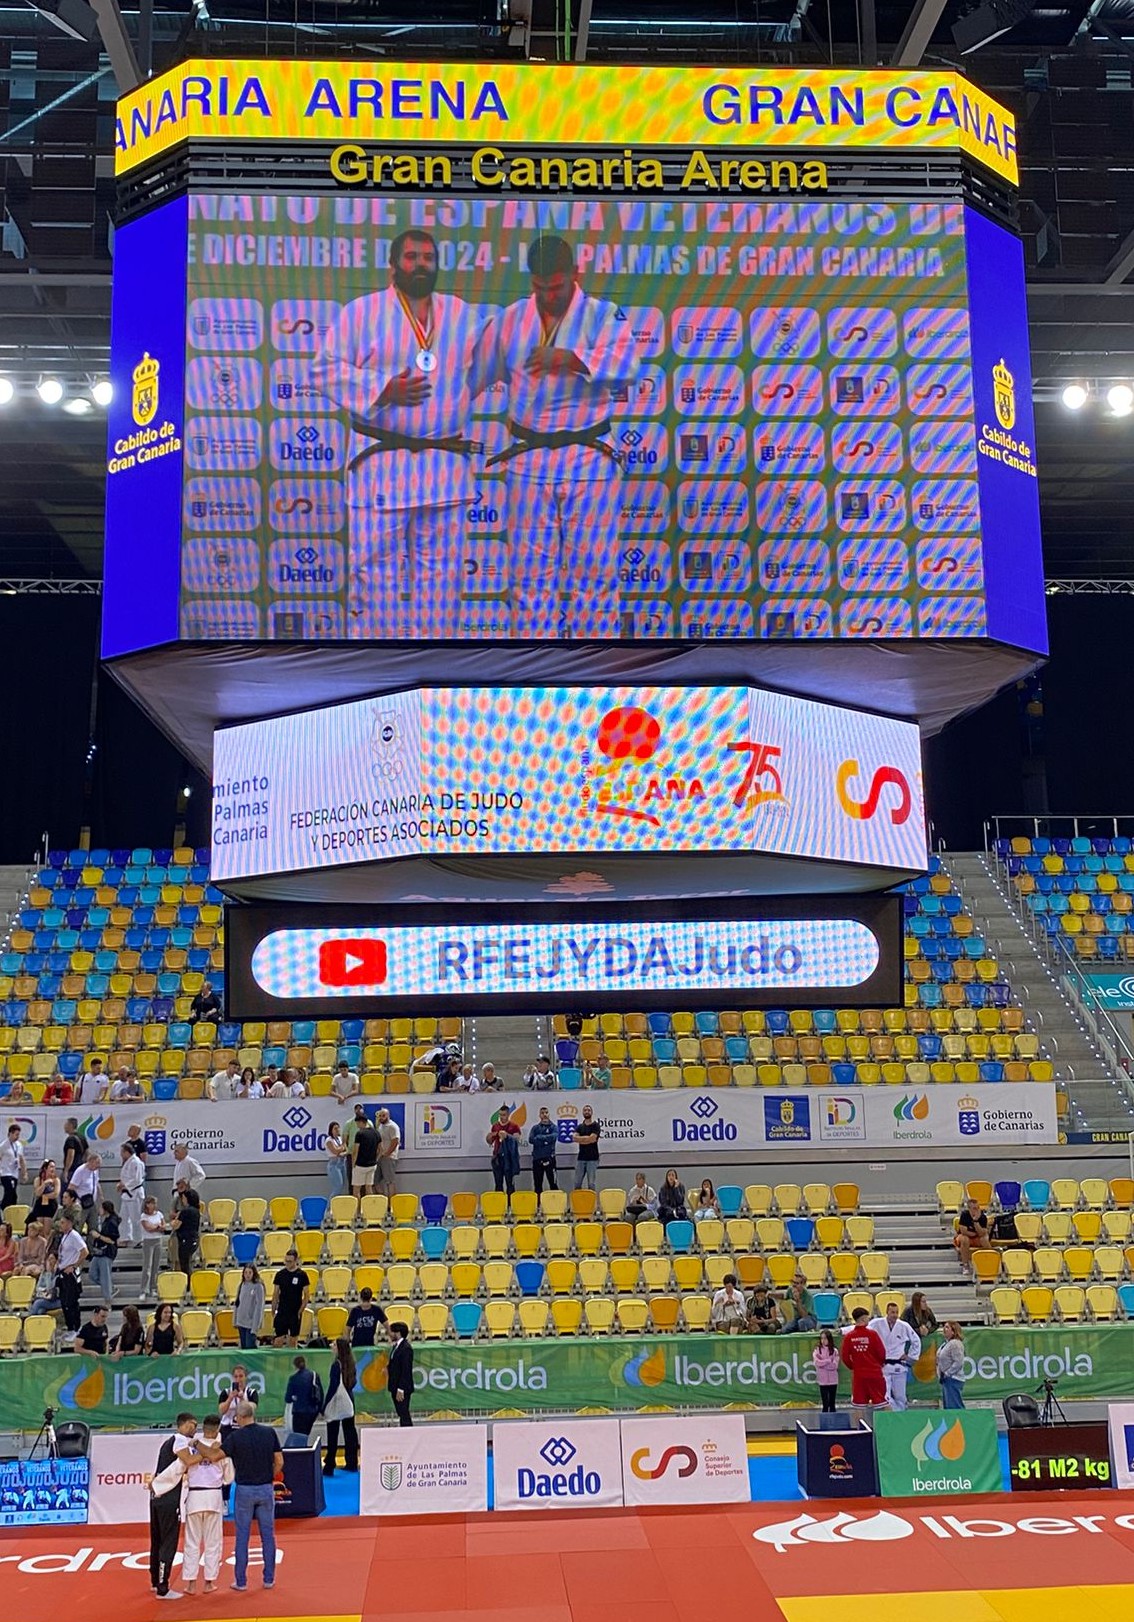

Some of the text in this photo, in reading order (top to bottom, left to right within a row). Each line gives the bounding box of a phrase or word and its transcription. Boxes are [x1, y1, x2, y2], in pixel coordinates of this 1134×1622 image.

[303, 78, 509, 121] ARENA
[702, 84, 865, 126] GRAN
[330, 144, 828, 189] Gran Canaria Arena
[335, 199, 397, 225] DE
[203, 233, 367, 268] DICIEMBRE
[438, 240, 493, 272] 024
[577, 242, 689, 275] PALMAS
[696, 246, 732, 276] DE
[738, 246, 815, 277] GRAN
[821, 246, 945, 277] CANARIA
[114, 421, 175, 455] Cabildo de
[982, 424, 1031, 458] Cabildo de
[108, 437, 181, 474] Gran Canaria
[280, 442, 334, 461] Daedo
[978, 439, 1037, 477] Gran Canaria
[467, 505, 499, 523] edo
[279, 563, 334, 582] Daedo
[620, 564, 660, 582] aedo
[727, 741, 782, 808] 75
[214, 799, 269, 822] Palmas
[290, 792, 523, 830] FEDERACIÓN CANARIA DE JUDO
[213, 822, 269, 846] Canaria
[311, 819, 489, 852] Y DEPORTES ASOCIADOS
[438, 936, 803, 980] RFEJYDAJudo
[597, 1118, 633, 1127] bierno
[983, 1110, 1033, 1120] Gobierno
[984, 1121, 1045, 1131] de Canarias
[170, 1129, 224, 1139] Gobierno
[672, 1118, 737, 1142] Daedo
[893, 1130, 932, 1140] Iberdrola
[1092, 1133, 1109, 1142] GRAN
[185, 1139, 235, 1150] Canarias
[412, 1359, 548, 1391] berdrola
[961, 1346, 1093, 1380] berdrola
[114, 1366, 266, 1406] Iberdroa
[407, 1462, 467, 1471] Ayuntamiento
[704, 1455, 730, 1464] Consejo
[1011, 1459, 1041, 1479] -81
[1049, 1457, 1079, 1478] M2
[1084, 1457, 1109, 1481] kg
[438, 1478, 467, 1486] Canaria
[518, 1465, 601, 1498] Daedo
[715, 1469, 743, 1477] Deportes
[913, 1476, 972, 1492] Iberdrola
